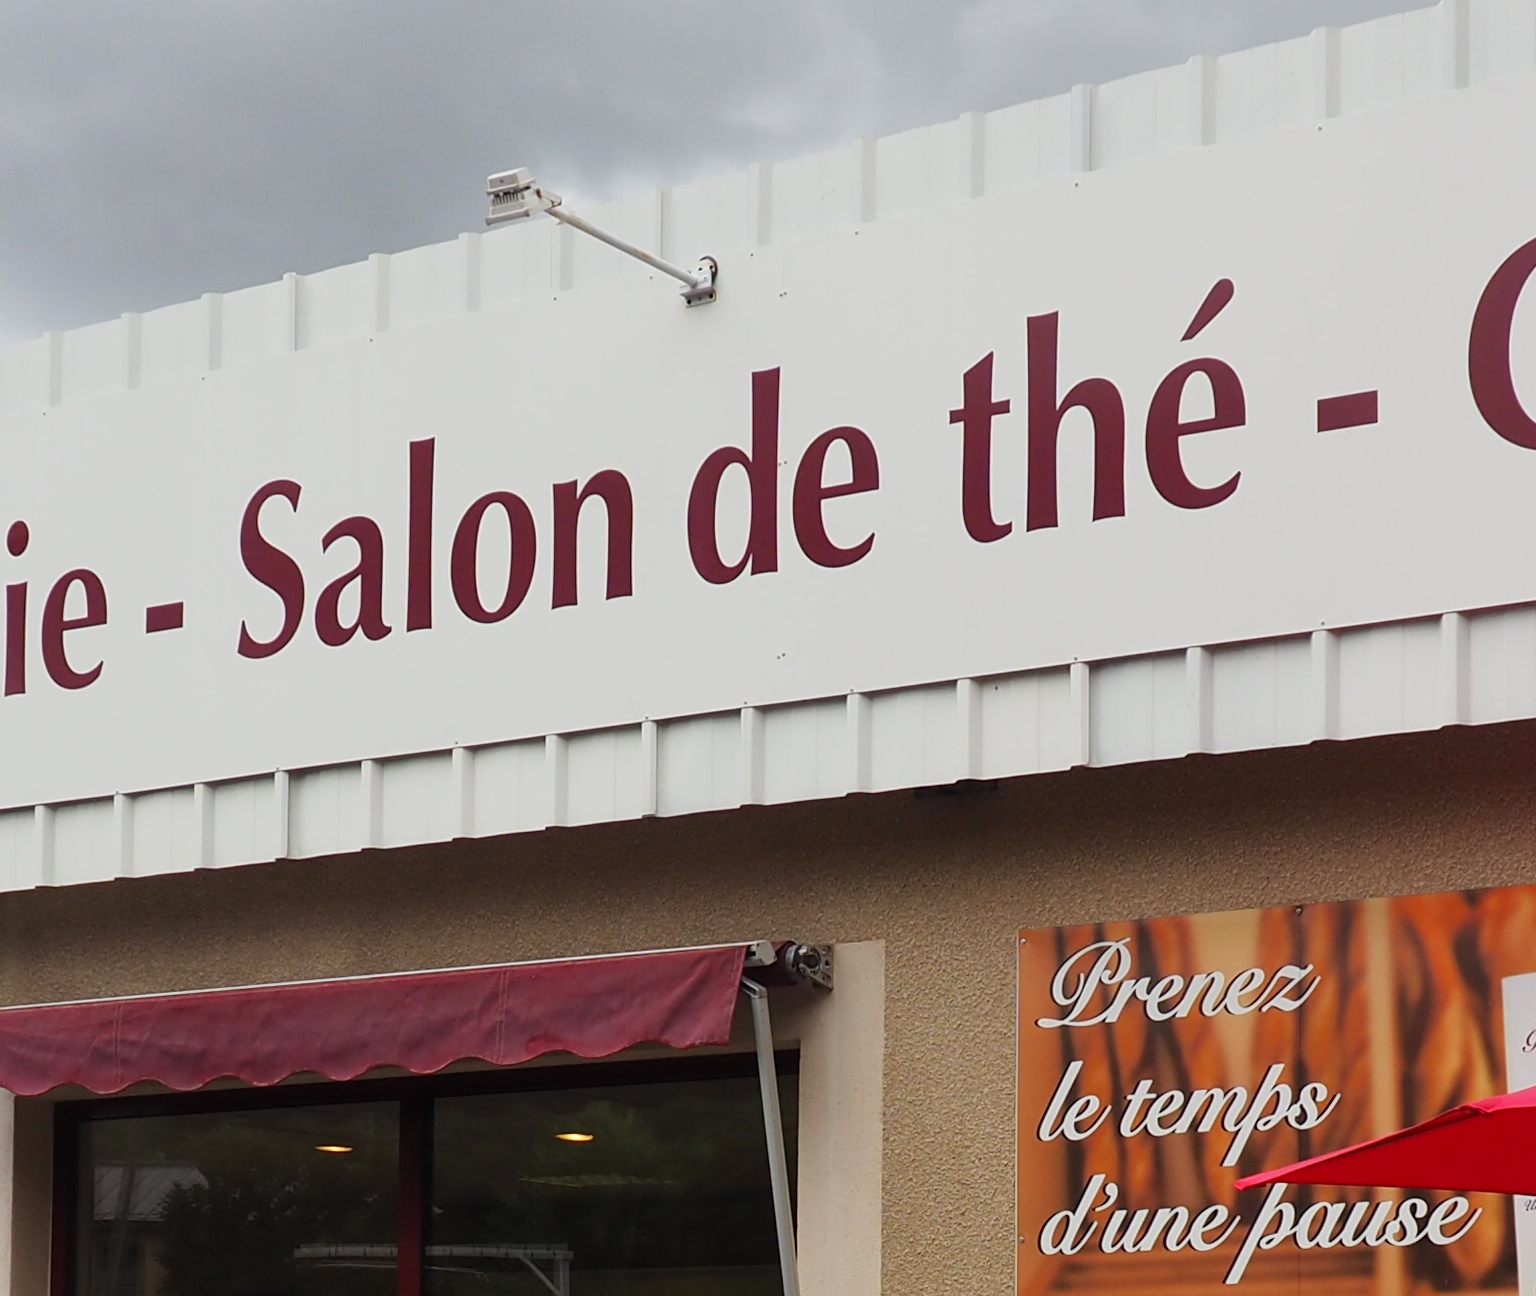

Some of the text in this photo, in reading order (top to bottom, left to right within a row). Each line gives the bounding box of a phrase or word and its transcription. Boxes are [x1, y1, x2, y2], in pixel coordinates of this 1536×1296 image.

[237, 436, 634, 660] Salon
[686, 365, 881, 585] de
[948, 277, 1247, 544] thé
[1035, 936, 1322, 1029] Prenez
[1037, 1059, 1341, 1168] le temps
[1037, 1173, 1483, 1285] d'une pause
